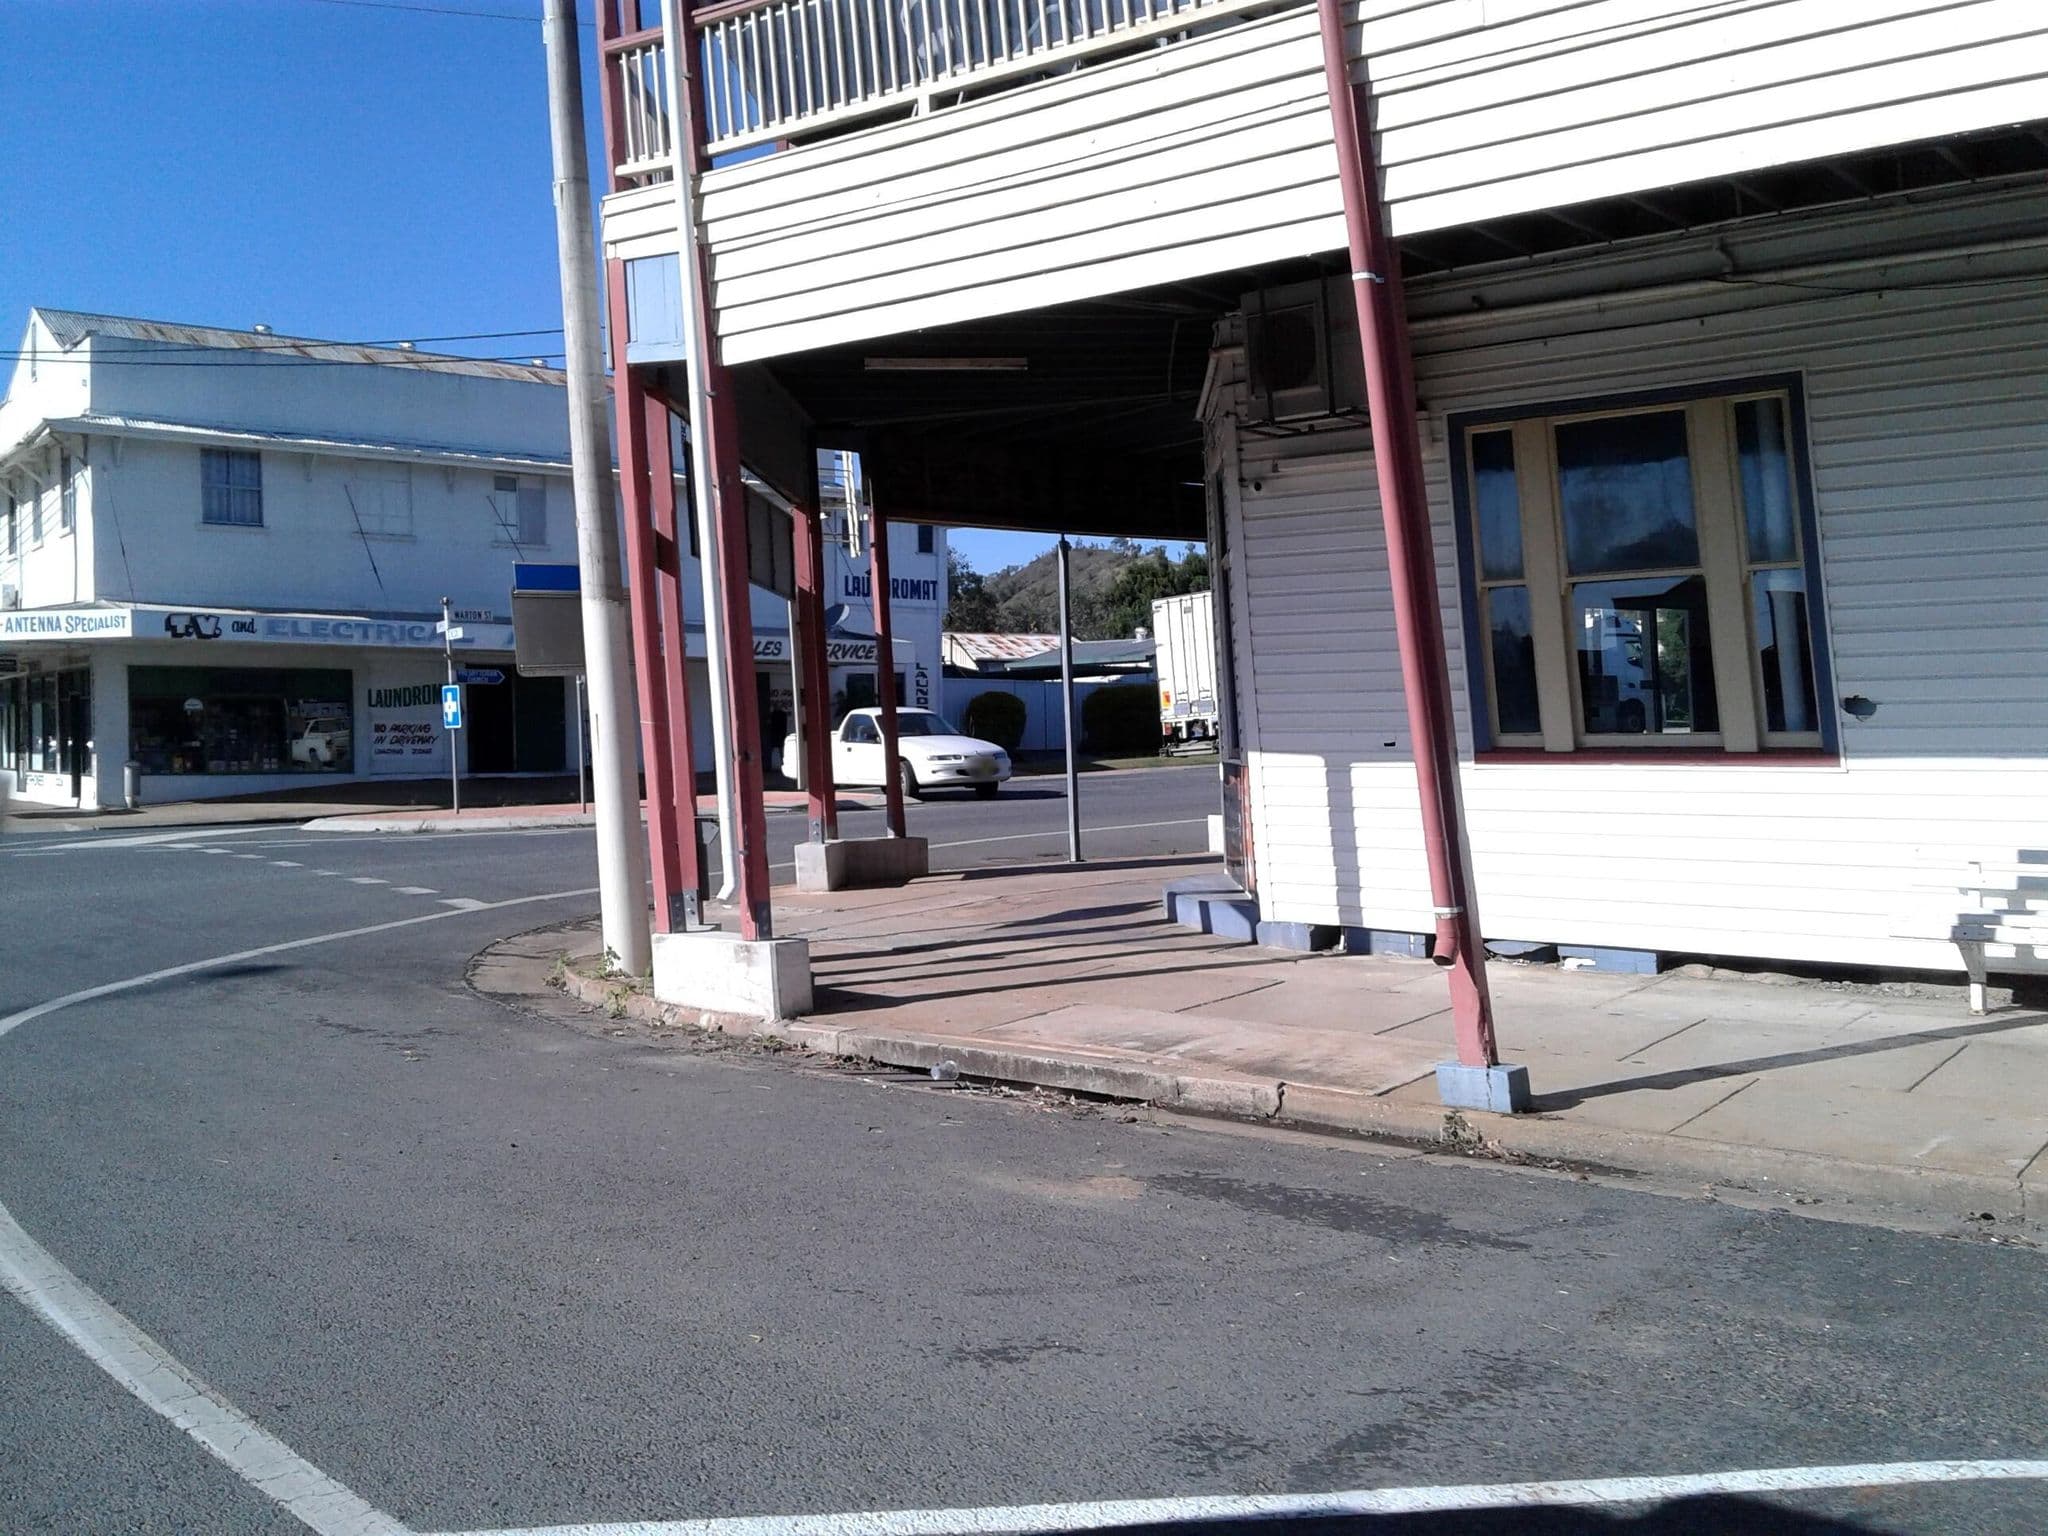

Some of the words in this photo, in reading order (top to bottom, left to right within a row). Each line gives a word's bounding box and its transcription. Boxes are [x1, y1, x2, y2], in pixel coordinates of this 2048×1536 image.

[844, 575, 938, 601] LAUROMAT
[5, 615, 62, 633] ANTENNA
[65, 615, 127, 633] SPECIALIST
[231, 617, 257, 634] and
[754, 640, 782, 657] LES
[826, 643, 876, 660] ERVICE
[367, 684, 443, 708] LAUNDROM
[914, 662, 929, 710] LAUND
[373, 735, 387, 745] IN
